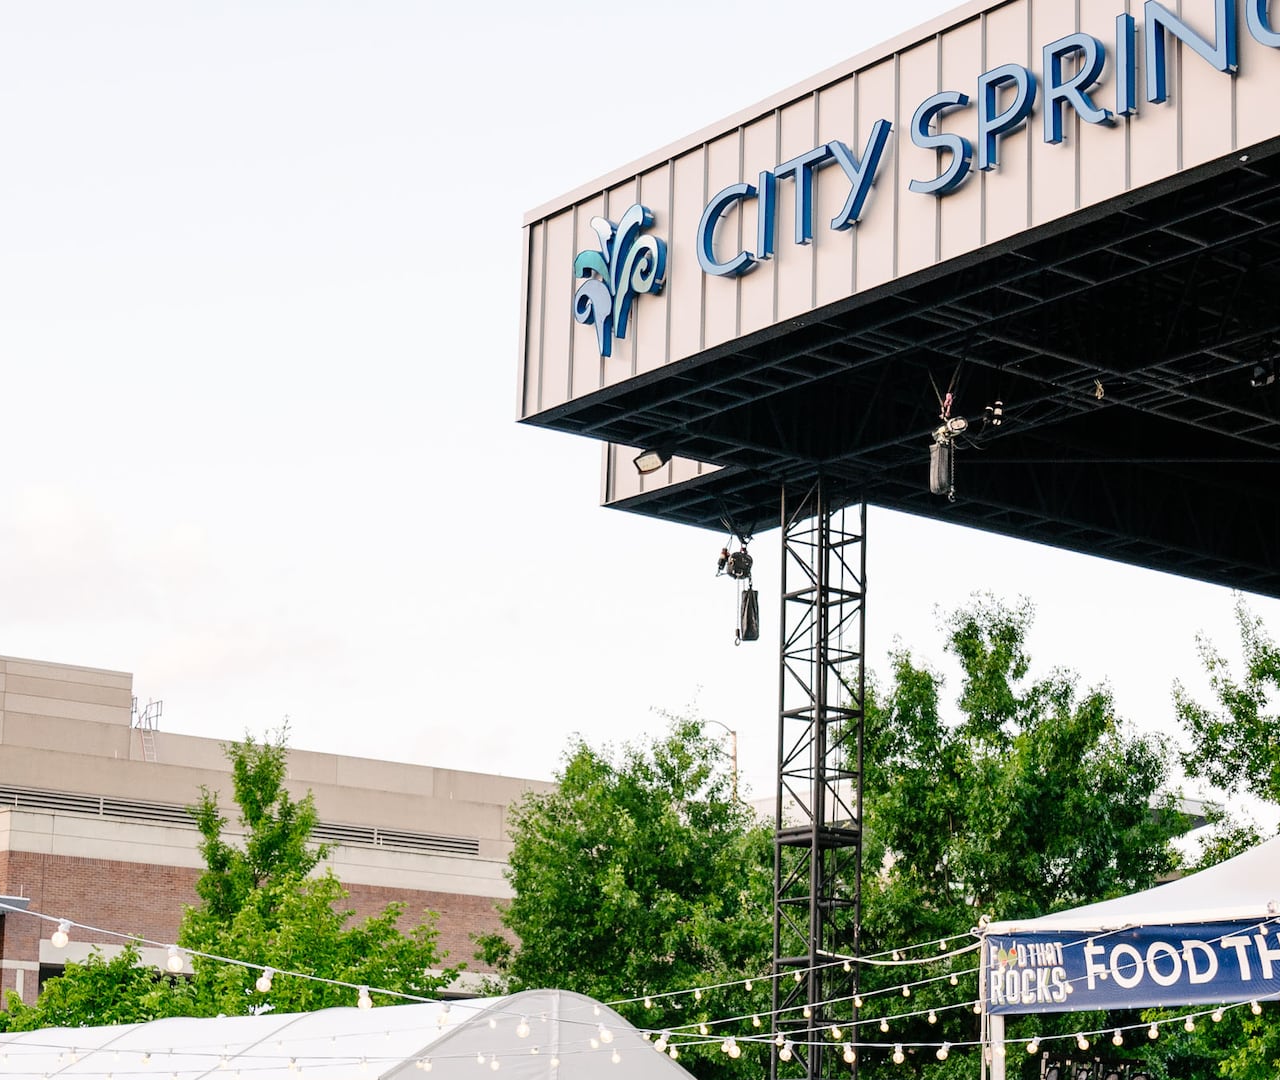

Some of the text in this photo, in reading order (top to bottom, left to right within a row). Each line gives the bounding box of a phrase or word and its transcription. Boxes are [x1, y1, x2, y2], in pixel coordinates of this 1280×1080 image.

[696, 118, 892, 279] CITY
[1027, 942, 1064, 967] THAT
[1084, 940, 1218, 990] FOOD
[991, 967, 1067, 1006] ROCKS
